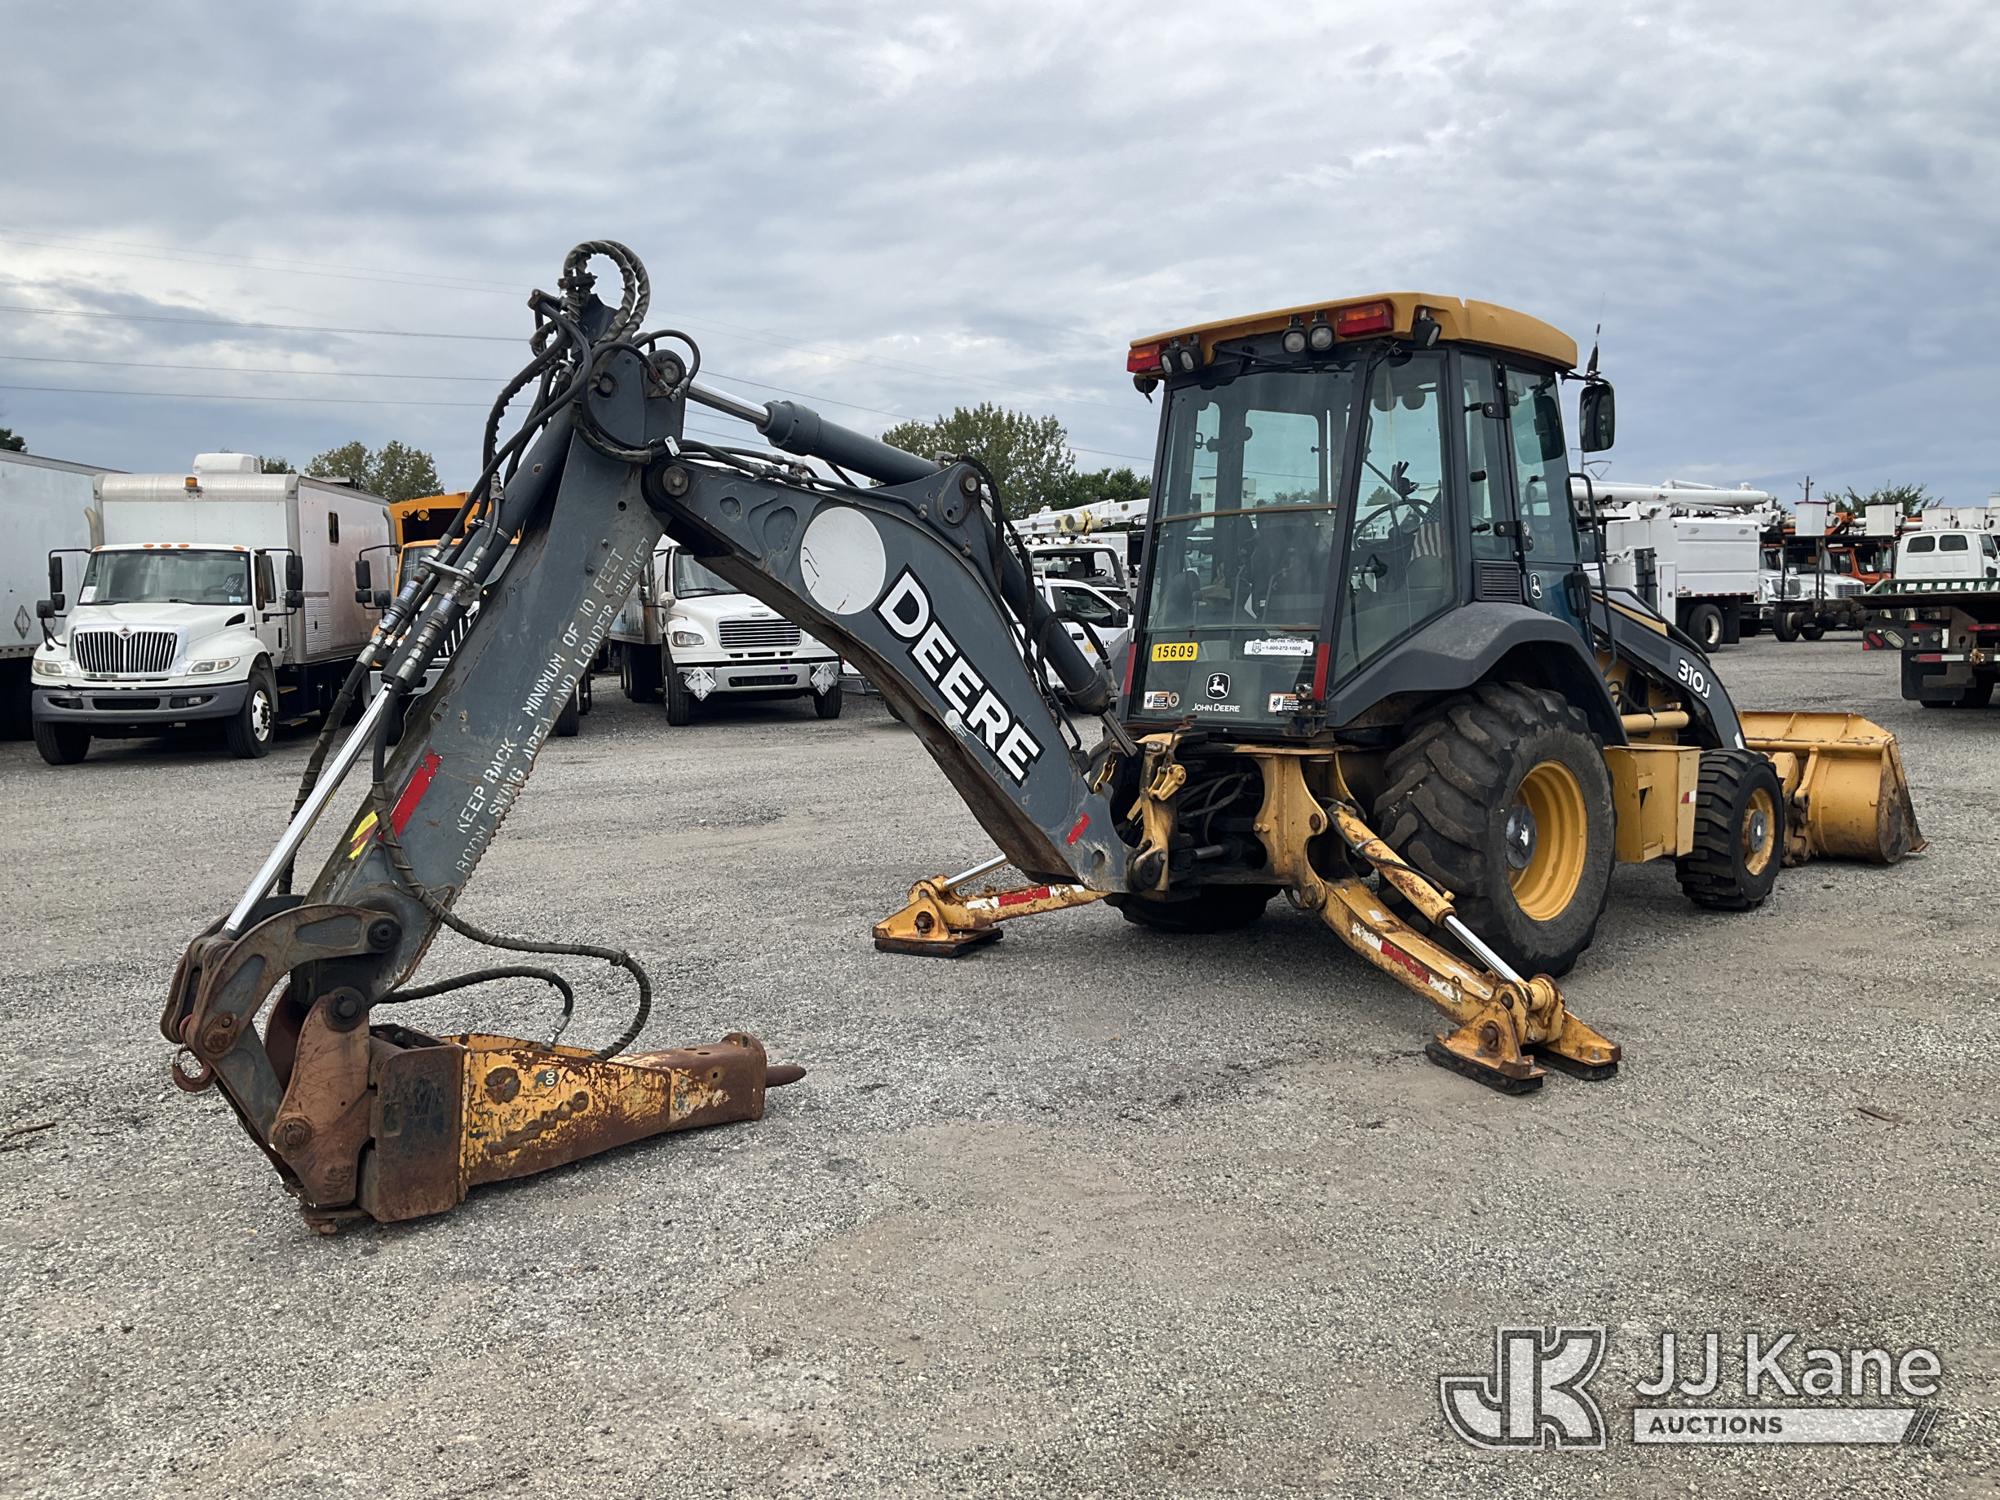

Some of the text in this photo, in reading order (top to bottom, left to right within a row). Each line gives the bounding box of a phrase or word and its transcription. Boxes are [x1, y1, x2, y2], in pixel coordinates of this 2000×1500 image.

[456, 785, 487, 834] KEEP
[483, 737, 518, 784] BACK
[522, 652, 566, 717] MINIMUM
[562, 622, 580, 648] OF
[579, 598, 596, 617] 10
[593, 547, 624, 593] FEET
[488, 767, 525, 817] SWING
[521, 716, 555, 761] AREA
[552, 673, 577, 708] AND
[574, 604, 615, 668] LOADER
[878, 571, 1041, 782] DEERE
[1156, 644, 1195, 659] 15609
[1191, 702, 1241, 713] JOHN DEERE
[1677, 659, 1712, 699] 310J
